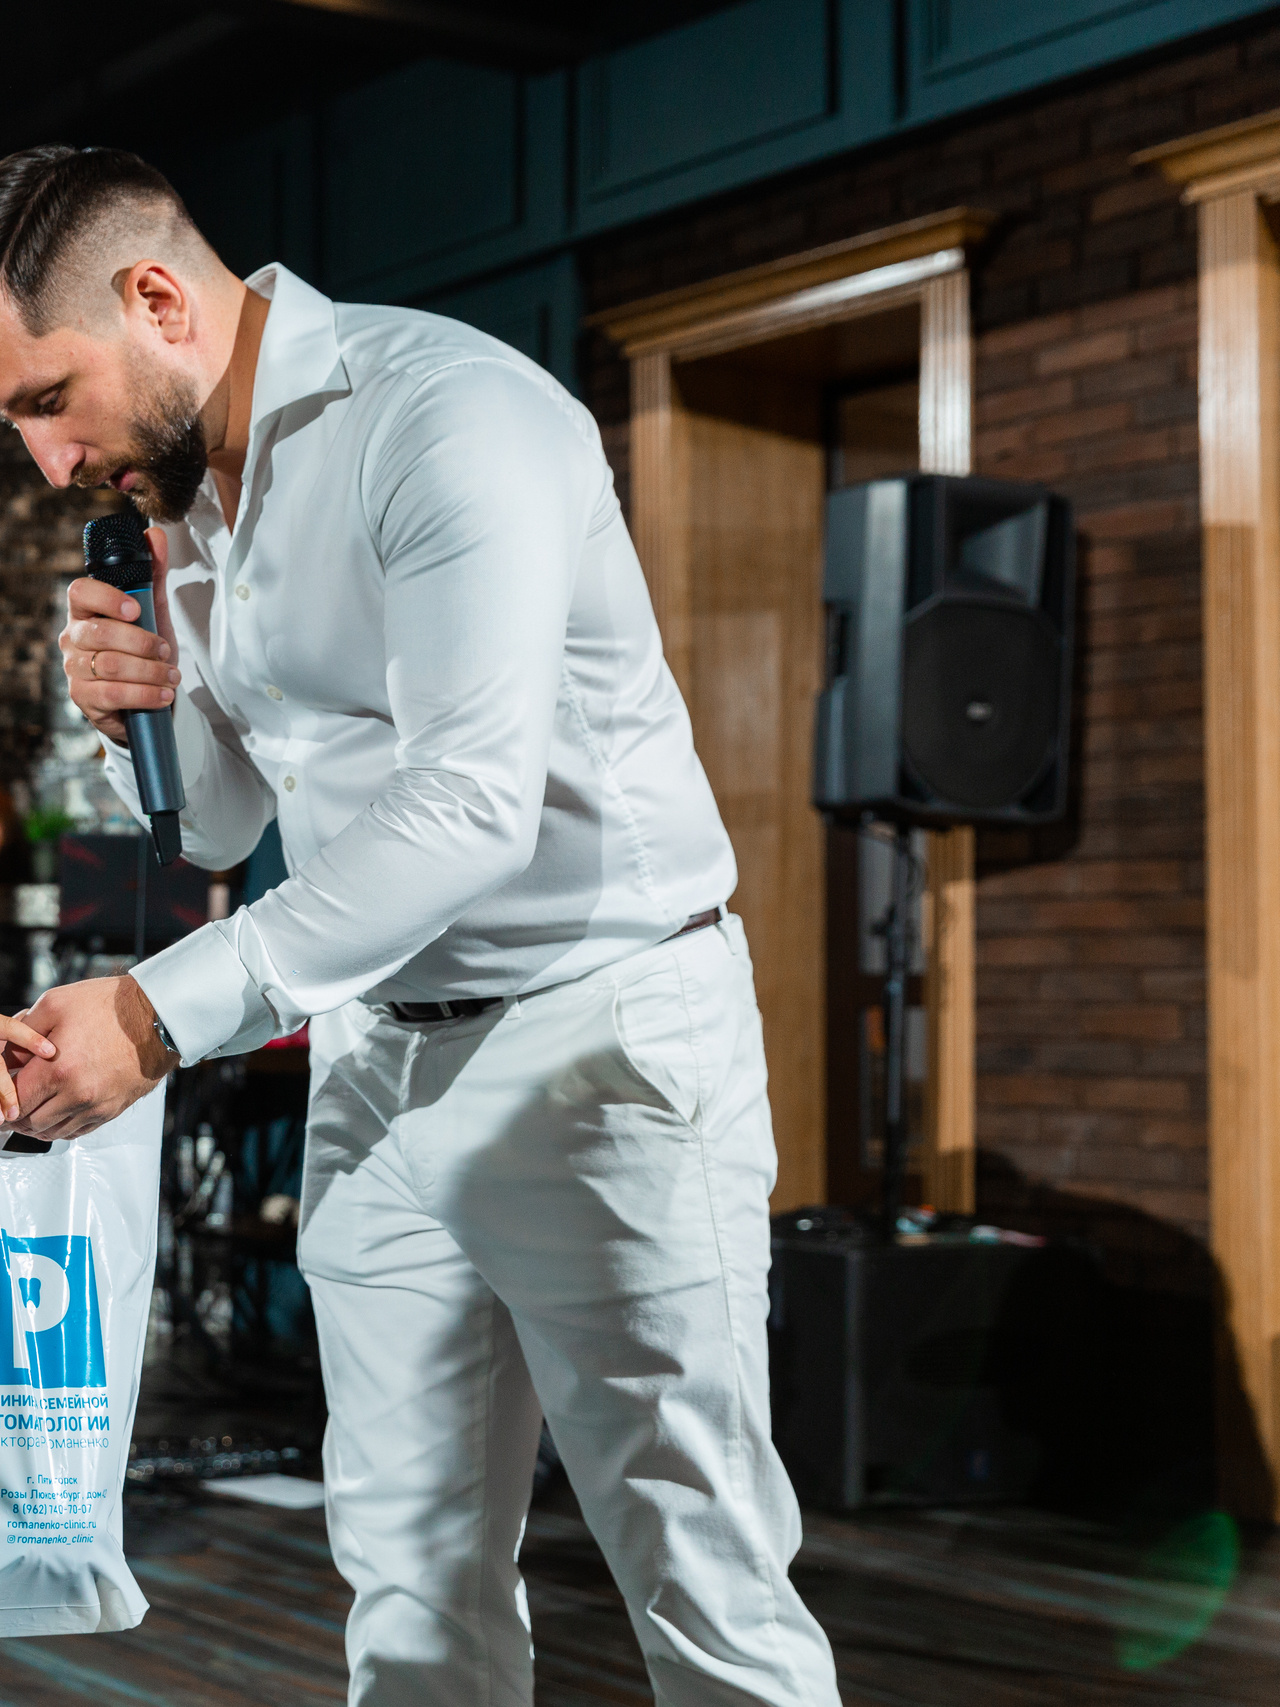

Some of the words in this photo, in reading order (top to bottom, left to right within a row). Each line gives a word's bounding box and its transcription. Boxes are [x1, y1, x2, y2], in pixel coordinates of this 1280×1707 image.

[40, 1393, 109, 1410] СЕМЕЙНОЙ
[0, 1488, 27, 1499] Розы
[30, 1488, 84, 1502] Люксебург,
[12, 1503, 19, 1514] 8
[22, 1503, 47, 1515] (962)
[7, 1519, 97, 1530] romanenko-clinic.ru
[17, 1534, 94, 1545] romanenko_clinic
